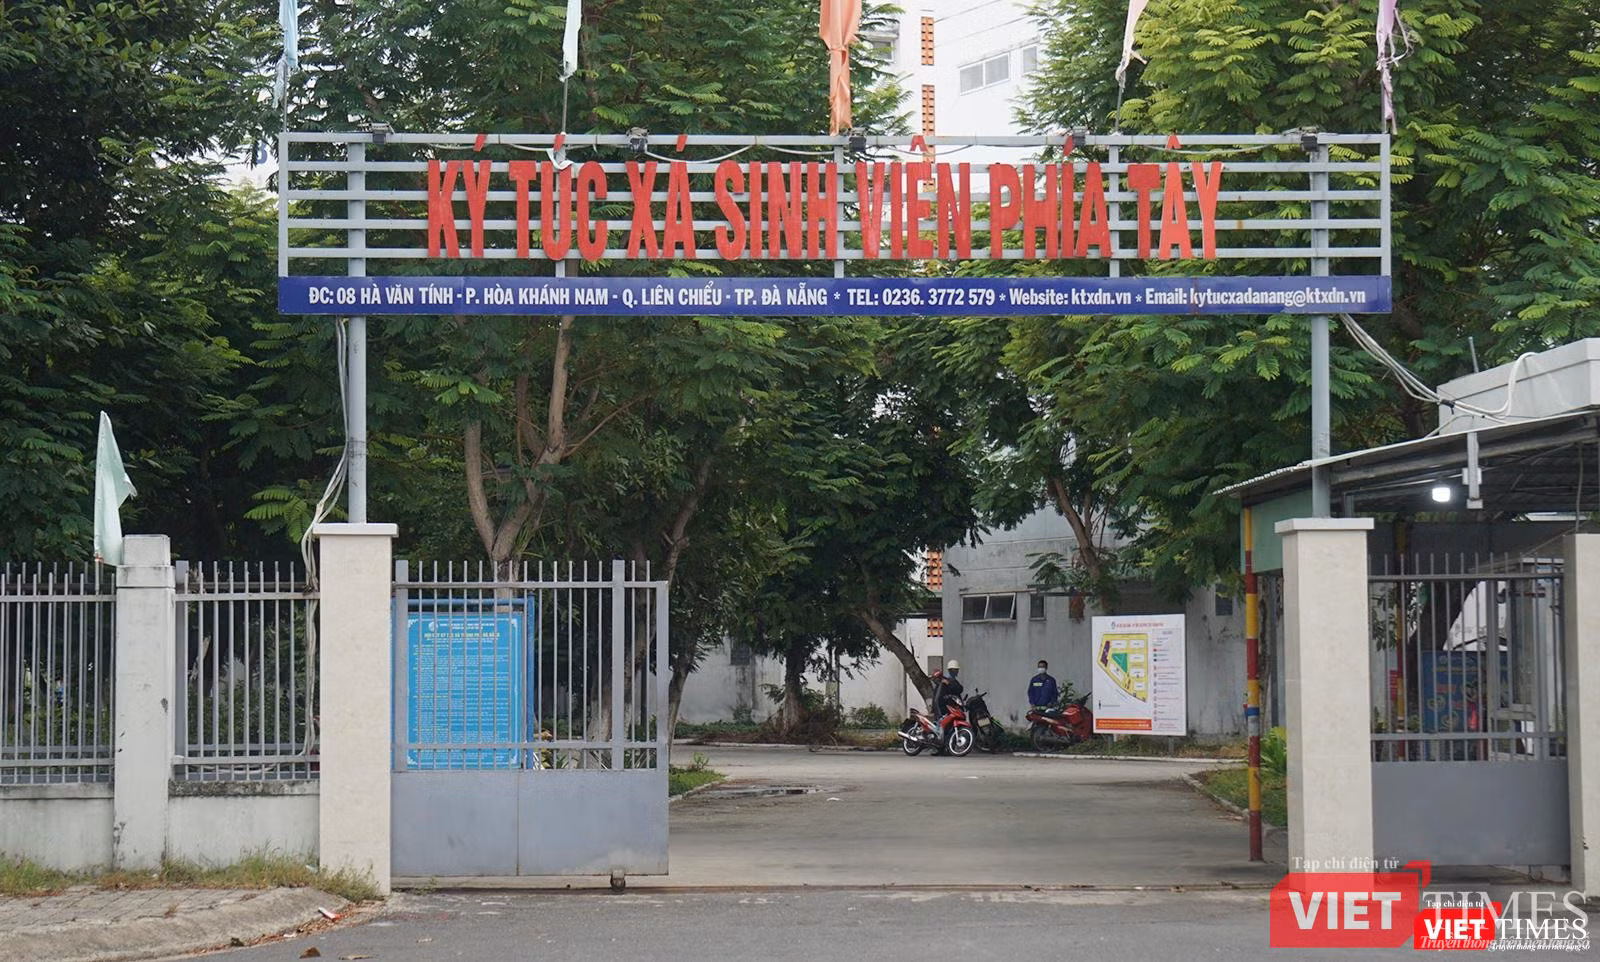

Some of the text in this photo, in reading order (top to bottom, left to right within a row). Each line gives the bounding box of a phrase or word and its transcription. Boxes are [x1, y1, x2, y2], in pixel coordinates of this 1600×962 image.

[428, 134, 1223, 261] KÝ TÚC XÁ SINH VIÊN PHÍA TÂY
[309, 287, 334, 304] ĐC:
[337, 287, 356, 305] 08
[361, 283, 382, 305] HÀ
[386, 284, 414, 305] VĂN
[419, 283, 453, 305] TÍNH
[466, 288, 480, 305] P.
[484, 283, 515, 305] HÒA
[519, 283, 570, 305] KHÁNH
[575, 288, 609, 305] NAM
[622, 288, 638, 308] Q.
[642, 284, 674, 306] LIÊN
[678, 280, 722, 306] CHIỂU
[735, 288, 757, 306] TP.
[762, 284, 782, 306] ĐÀ
[787, 282, 828, 306] NẴNG
[847, 288, 879, 306] TEL:
[883, 288, 925, 306] 0236.
[928, 288, 965, 306] 3772
[969, 288, 996, 306] 579
[1009, 288, 1069, 306] Website:
[1072, 287, 1132, 305] ktxdn.vn
[1146, 287, 1188, 305] Email:
[1190, 287, 1366, 308] kytucxadanang@ktxdn.vn
